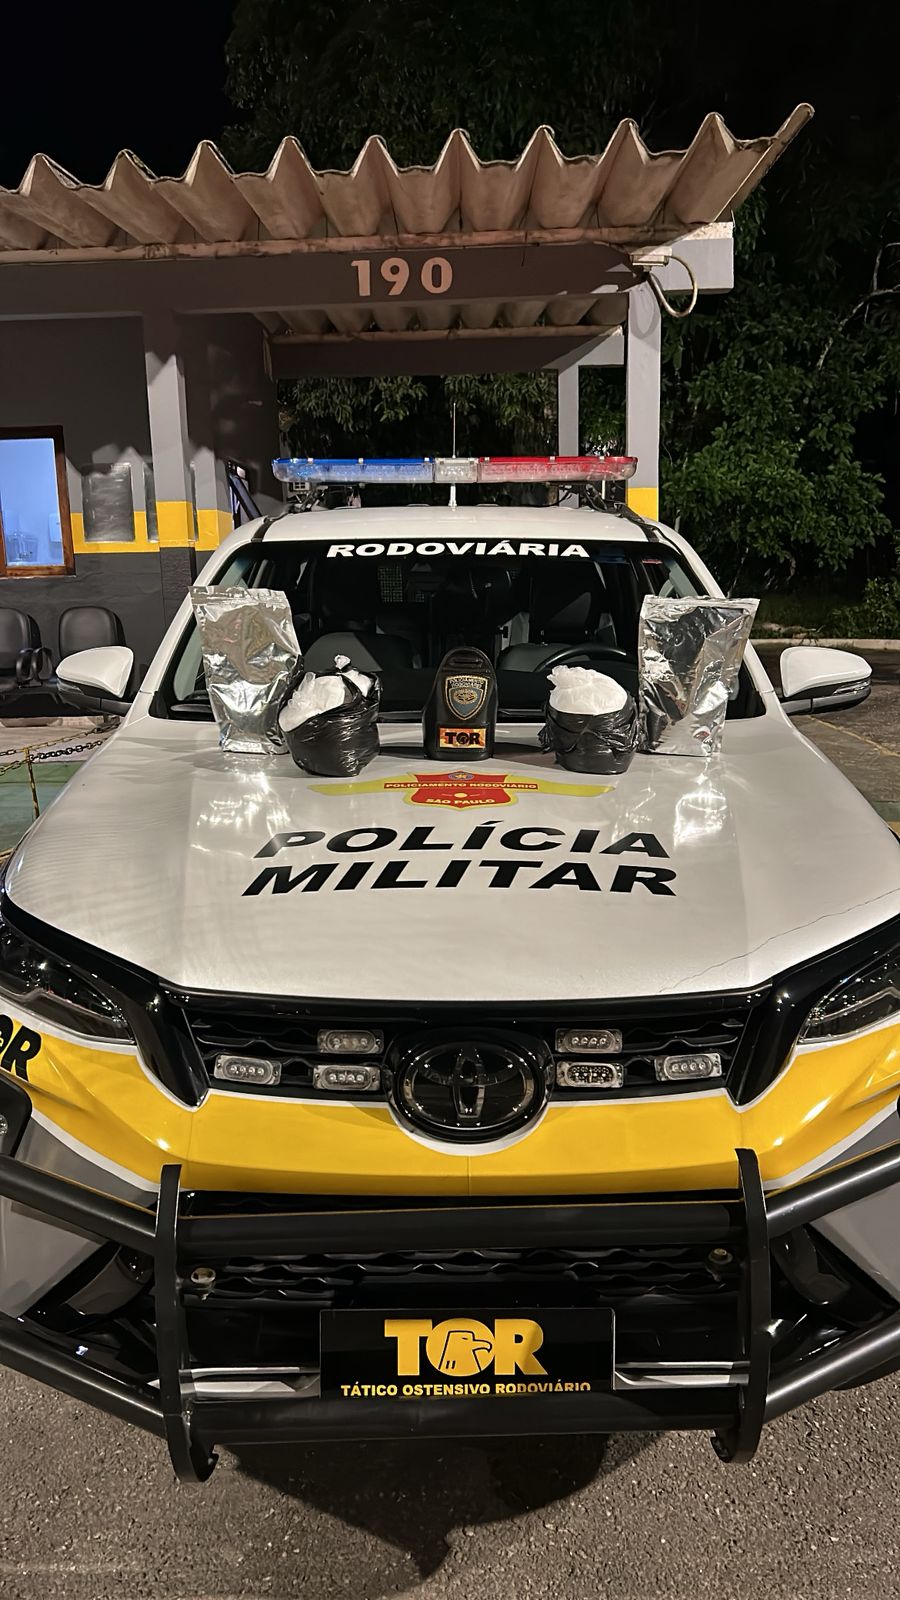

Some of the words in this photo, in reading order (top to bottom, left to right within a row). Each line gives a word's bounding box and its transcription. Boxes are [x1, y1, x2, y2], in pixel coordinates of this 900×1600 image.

[351, 256, 452, 295] 190
[326, 540, 590, 557] RODOVIÁRIA
[445, 732, 480, 746] TOR
[253, 821, 671, 858] POLÍCIA
[241, 859, 677, 897] MILITAR
[384, 1318, 548, 1377] TOR
[341, 1381, 398, 1397] TÁTICO
[402, 1384, 490, 1396] OSTENSIVO
[495, 1379, 591, 1394] RODOVIÁRIO
